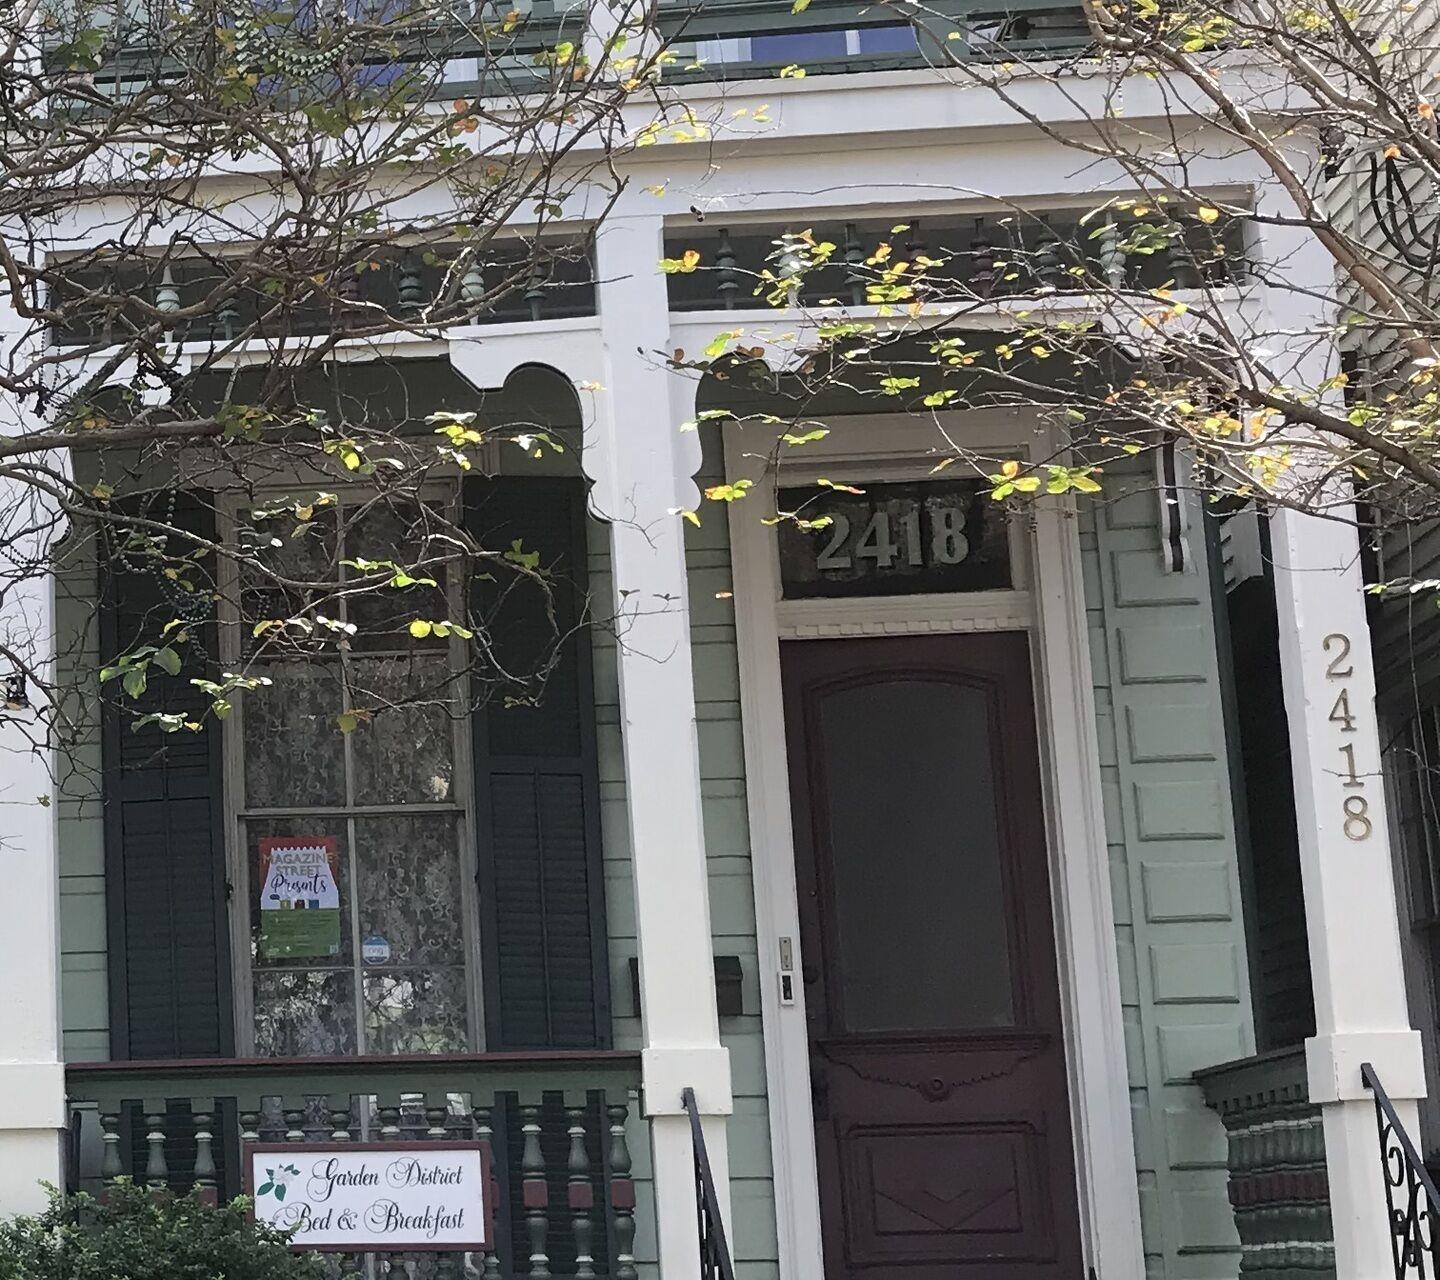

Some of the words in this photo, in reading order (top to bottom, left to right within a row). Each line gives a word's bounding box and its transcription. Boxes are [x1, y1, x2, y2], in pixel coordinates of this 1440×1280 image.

[817, 506, 969, 569] 2418
[1323, 633, 1372, 841] 2418
[262, 853, 336, 864] MAGAZINE
[276, 865, 322, 876] STREET
[307, 1158, 379, 1202] Garden
[386, 1157, 464, 1189] District
[273, 1201, 331, 1233] Bed
[337, 1208, 358, 1231] &
[364, 1199, 465, 1239] Breakfast
